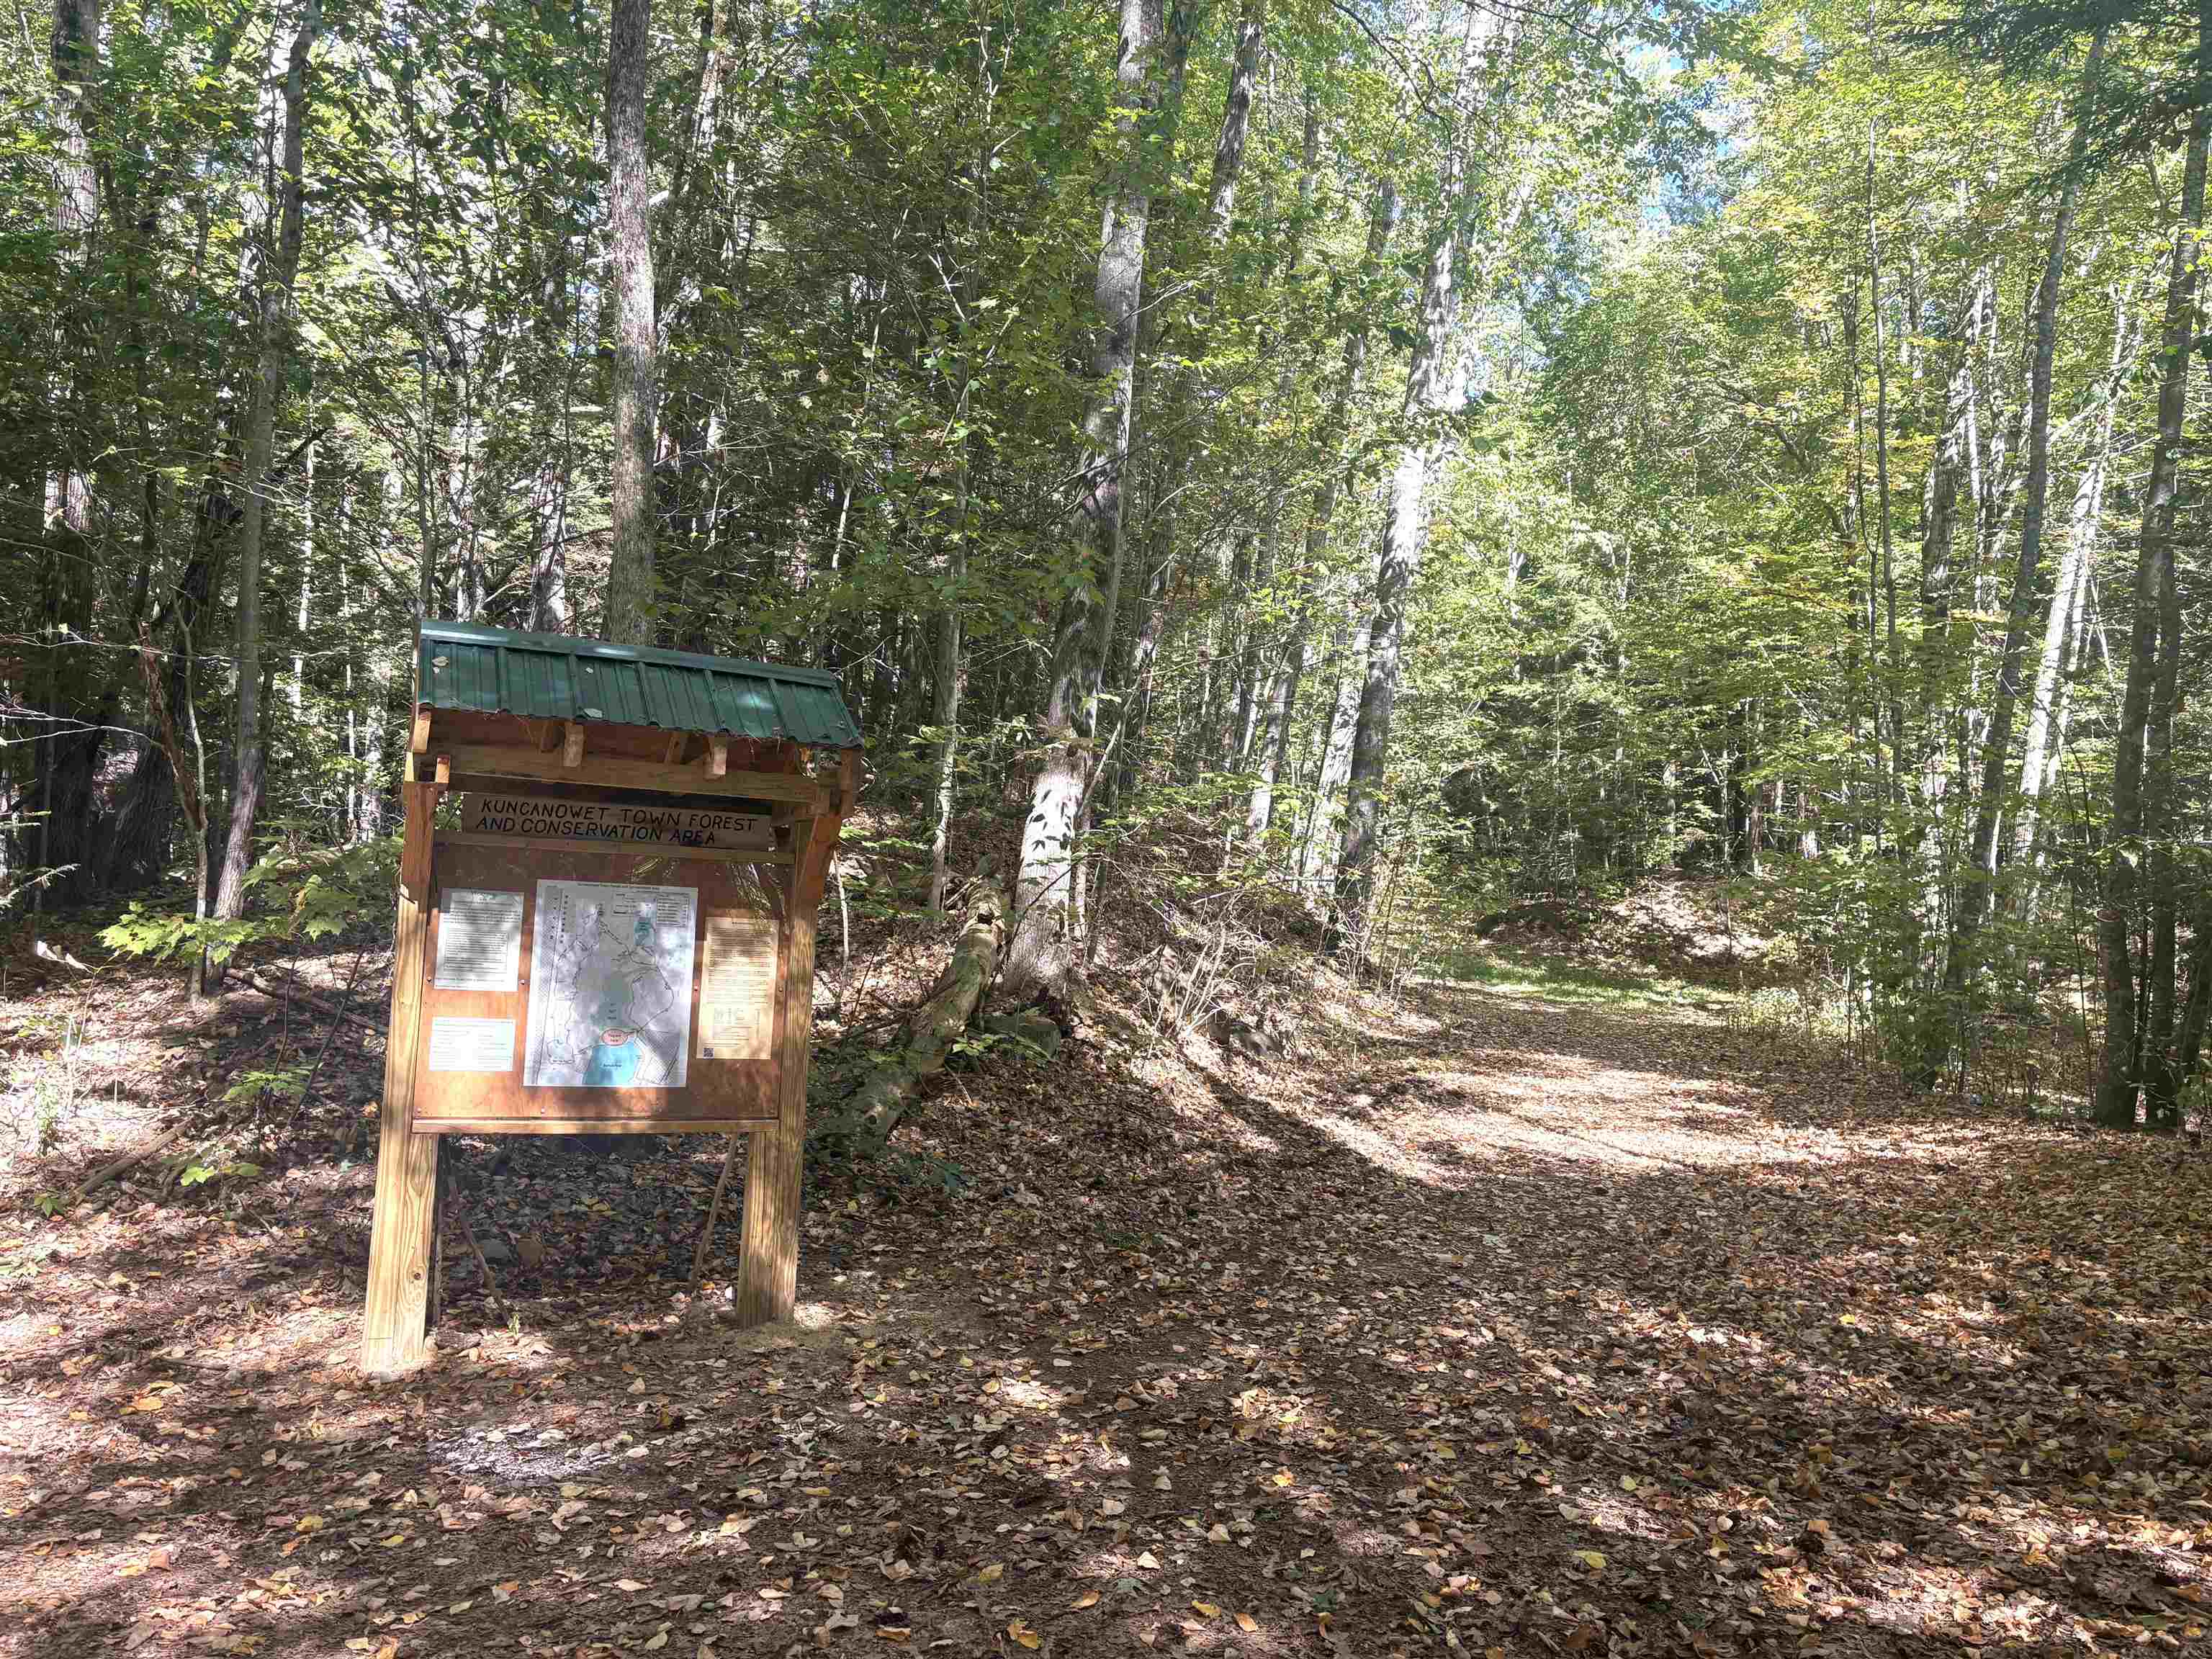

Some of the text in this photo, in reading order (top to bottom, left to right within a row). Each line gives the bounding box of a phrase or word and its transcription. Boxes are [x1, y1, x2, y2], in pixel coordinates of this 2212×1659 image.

[476, 815, 716, 845] AND CONSERVATION AREA
[480, 798, 758, 832] KUNCANOWET TOWN FOREST
